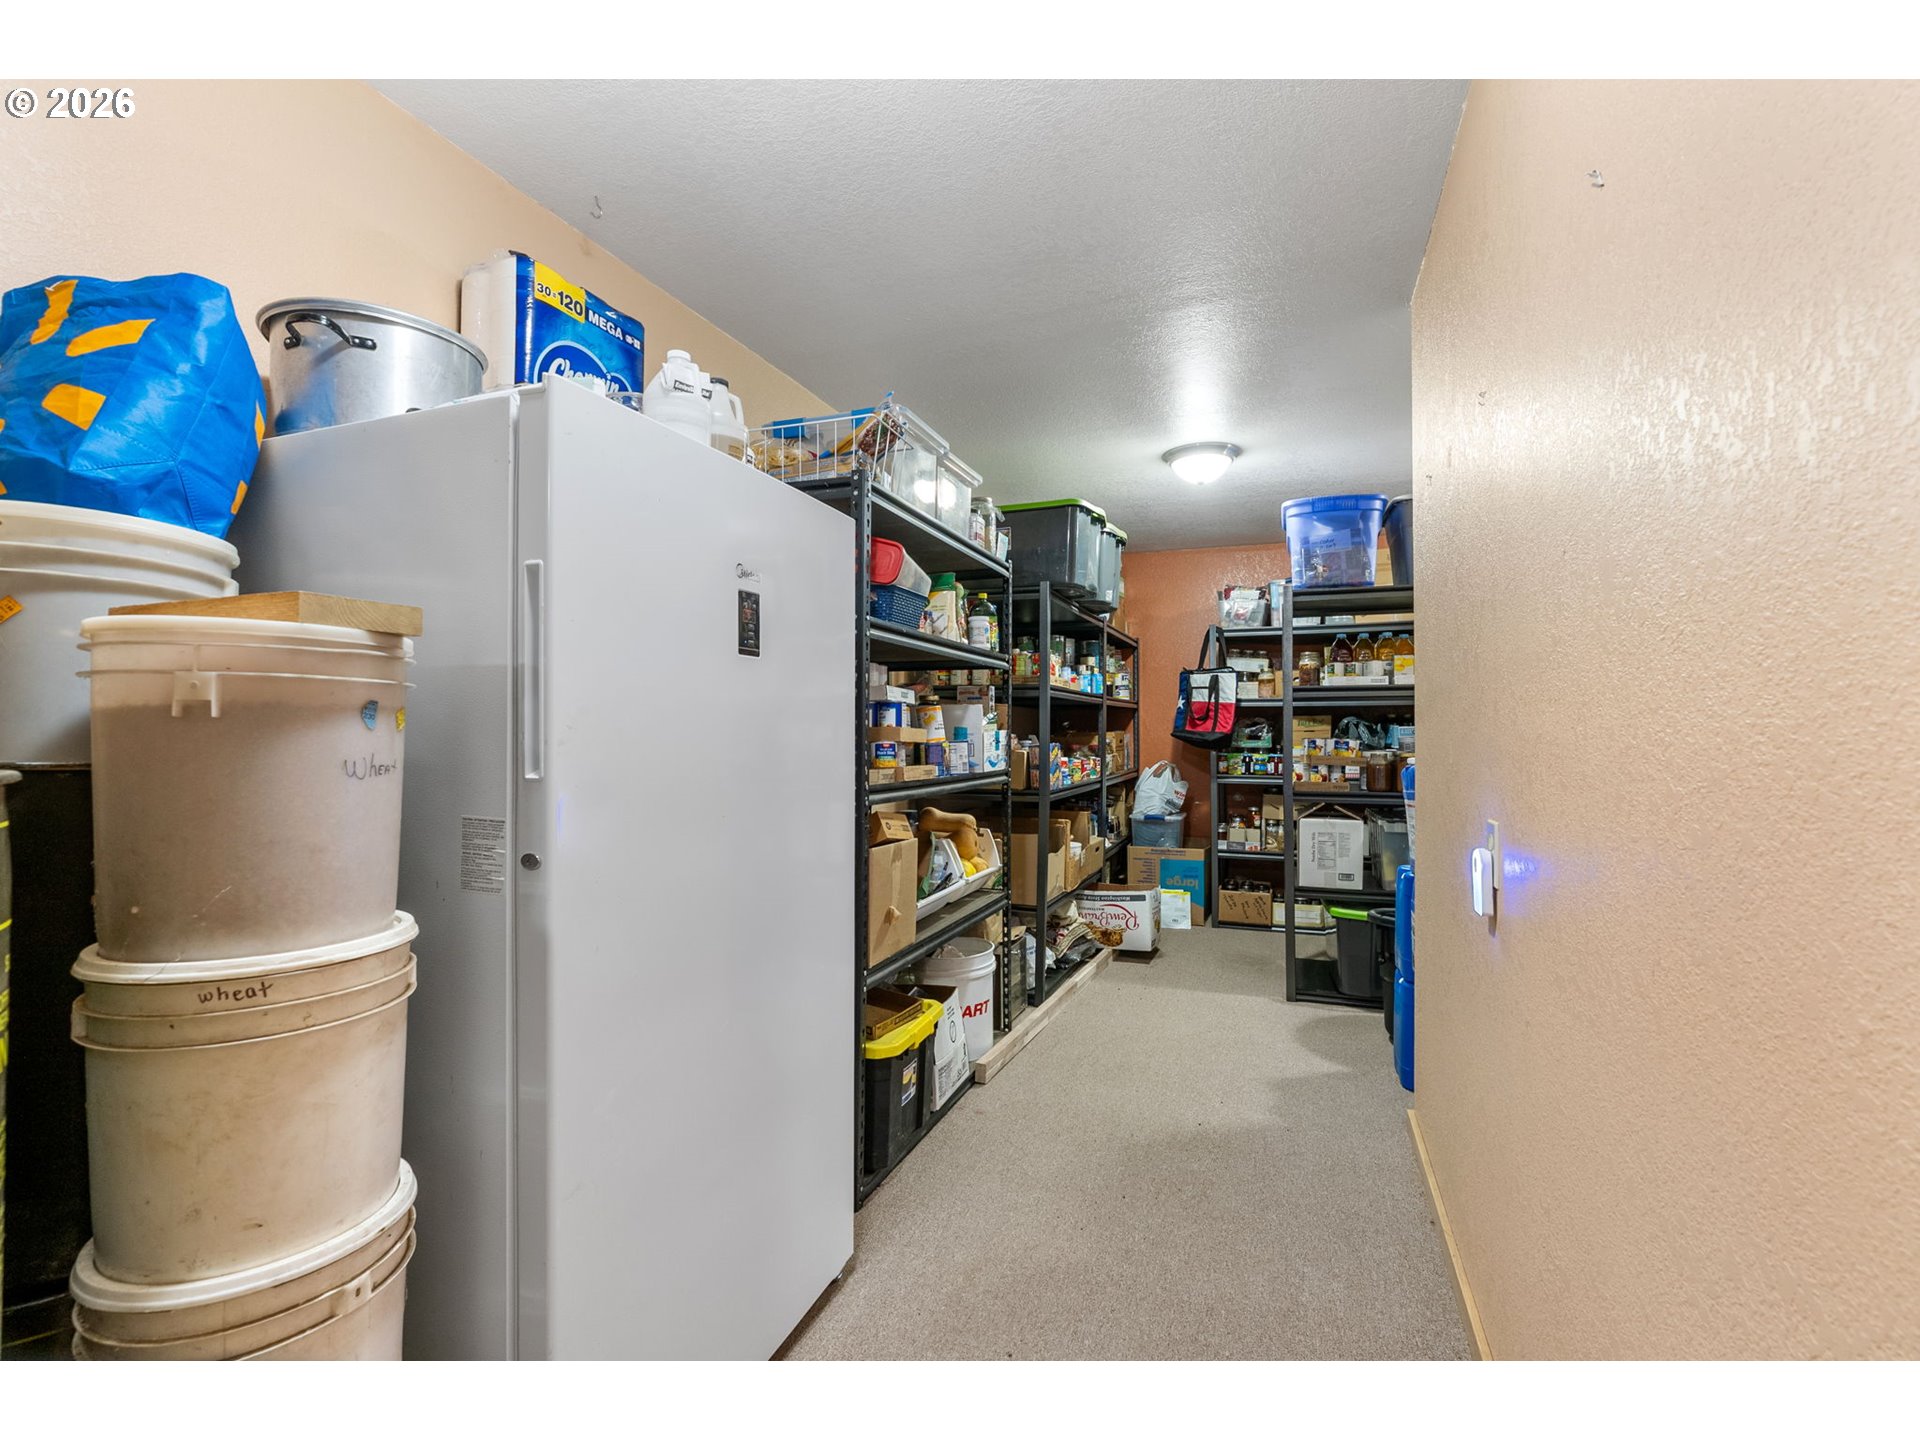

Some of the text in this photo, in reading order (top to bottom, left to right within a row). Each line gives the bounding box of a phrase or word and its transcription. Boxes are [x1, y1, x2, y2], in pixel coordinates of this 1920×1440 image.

[537, 283, 551, 297] 30
[558, 290, 584, 317] 120
[588, 309, 624, 341] MEGA
[1167, 875, 1199, 889] large
[1079, 903, 1139, 931] RemBran
[198, 981, 274, 1004] wheat
[960, 999, 990, 1018] ART
